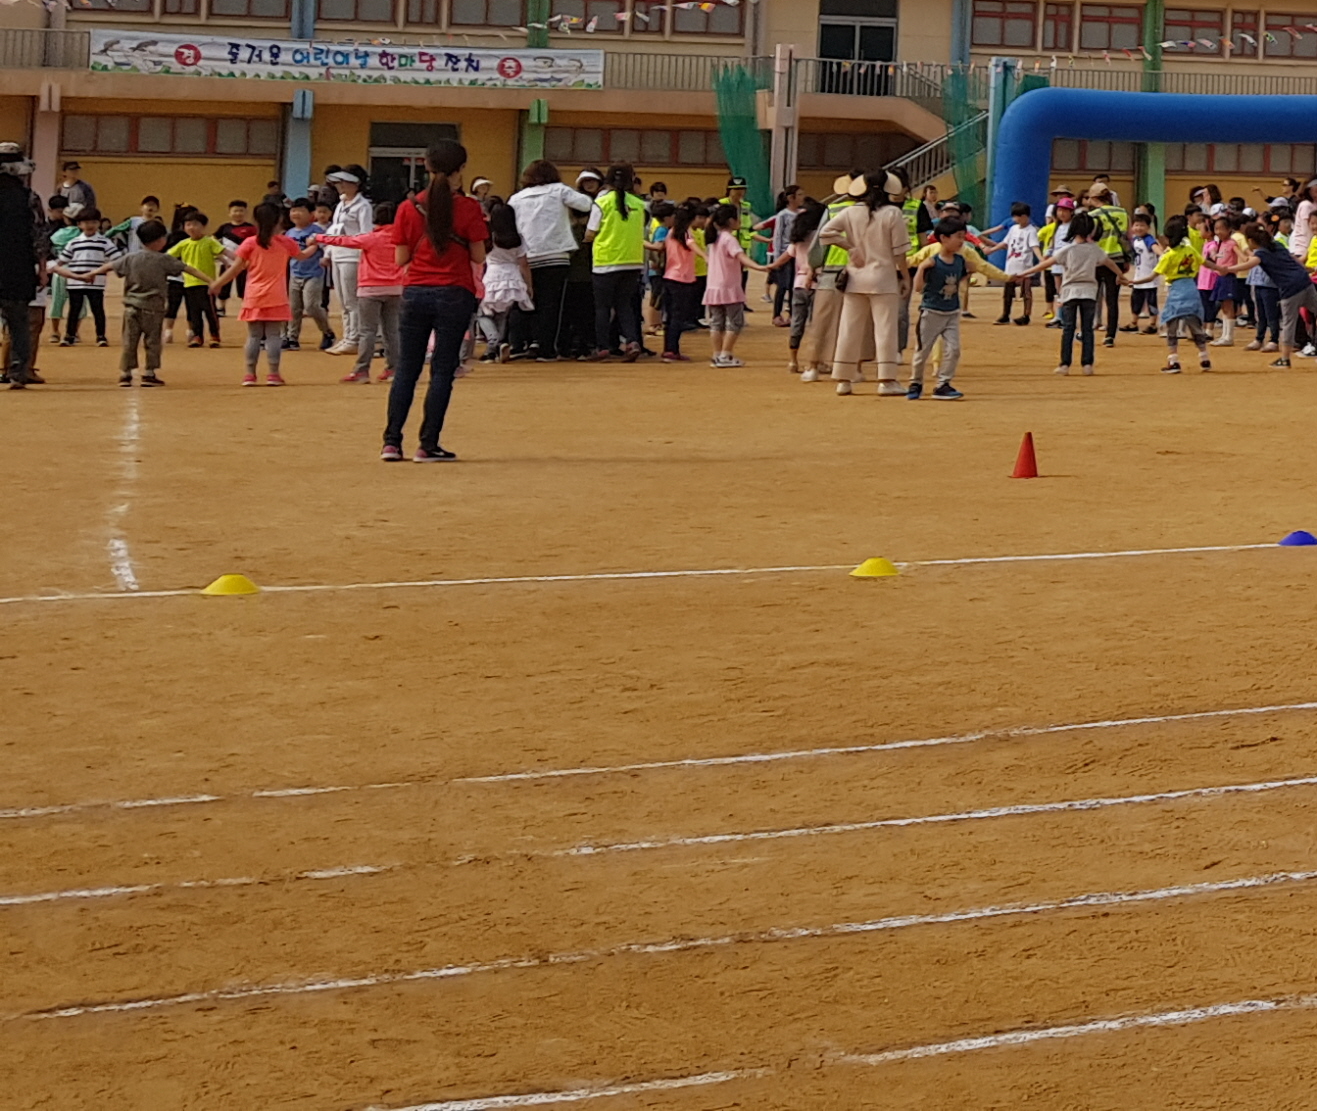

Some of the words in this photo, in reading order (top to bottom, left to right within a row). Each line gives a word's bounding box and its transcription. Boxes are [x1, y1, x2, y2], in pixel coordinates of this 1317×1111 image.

[227, 42, 281, 66] 즐거운
[292, 46, 370, 69] 어린이날
[378, 50, 436, 72] 한마당
[444, 52, 480, 73] 잔치
